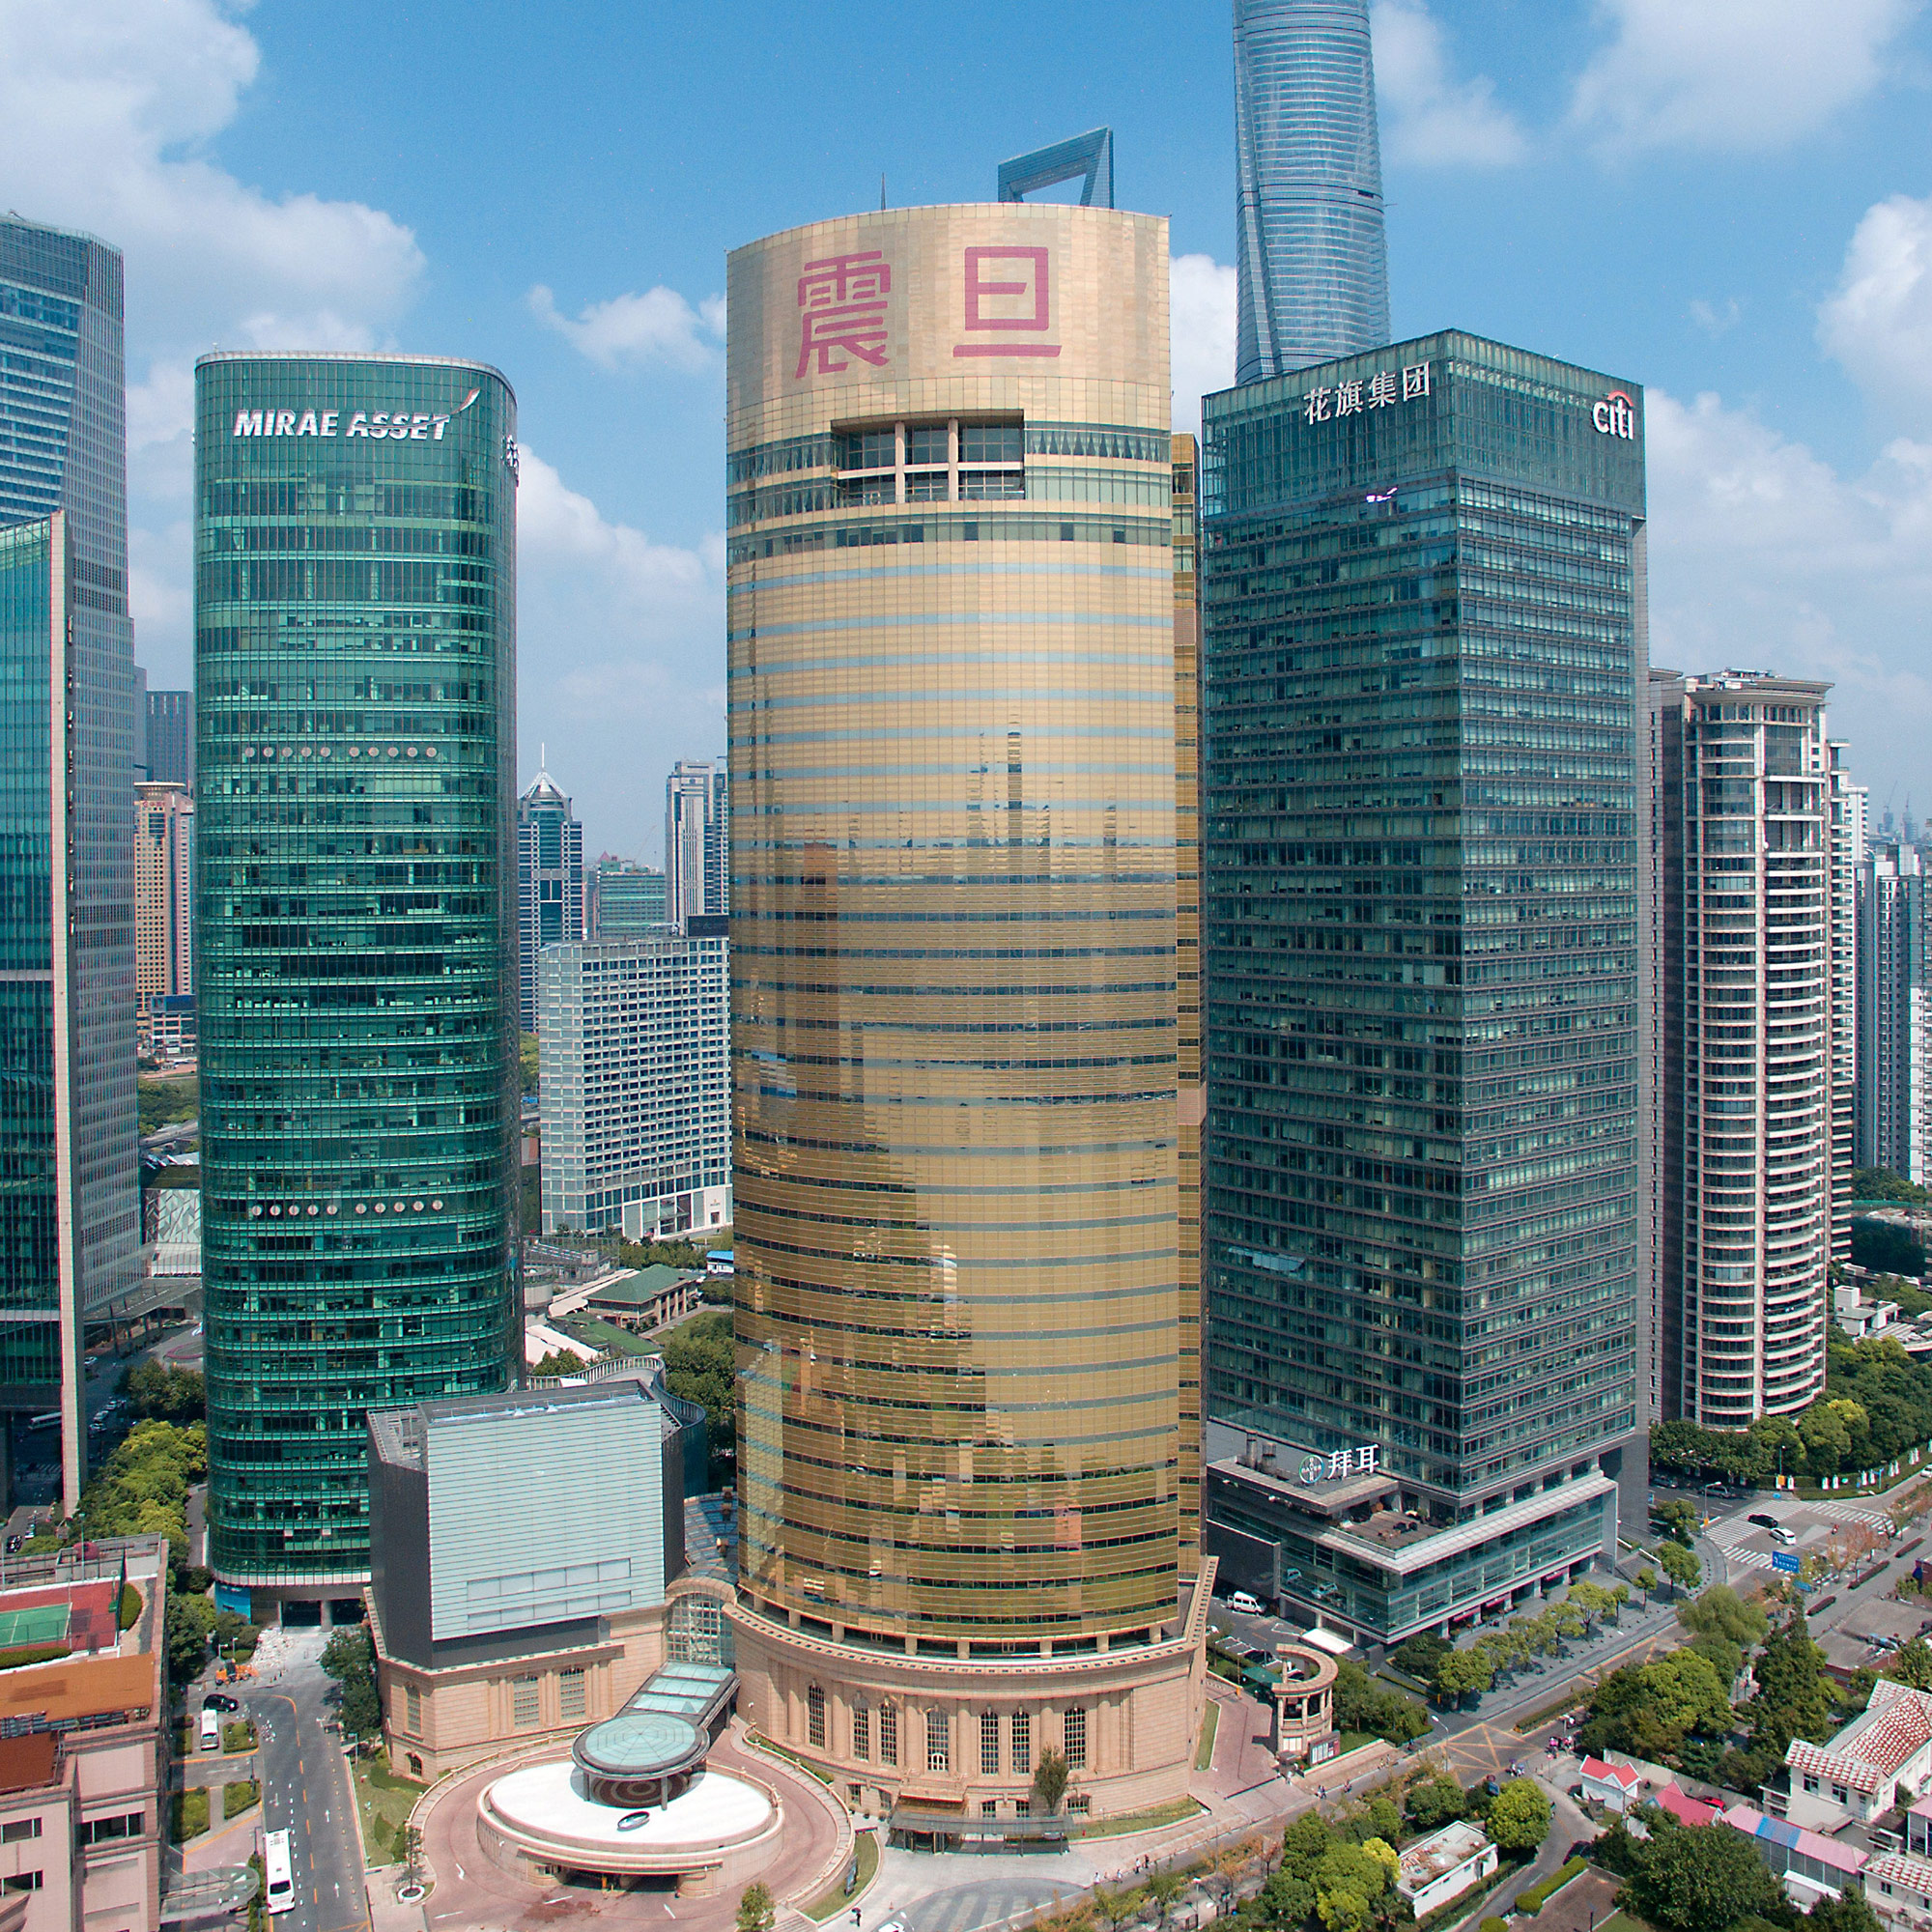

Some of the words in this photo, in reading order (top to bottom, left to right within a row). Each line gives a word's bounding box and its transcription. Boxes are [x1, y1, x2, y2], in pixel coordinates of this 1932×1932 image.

[796, 245, 1063, 379] 震旦
[1303, 361, 1430, 425] 花旗集团
[234, 409, 339, 438] MIRAE
[346, 411, 450, 440] ASSET
[1592, 398, 1634, 440] citi
[1327, 1443, 1380, 1479] 拜耳
